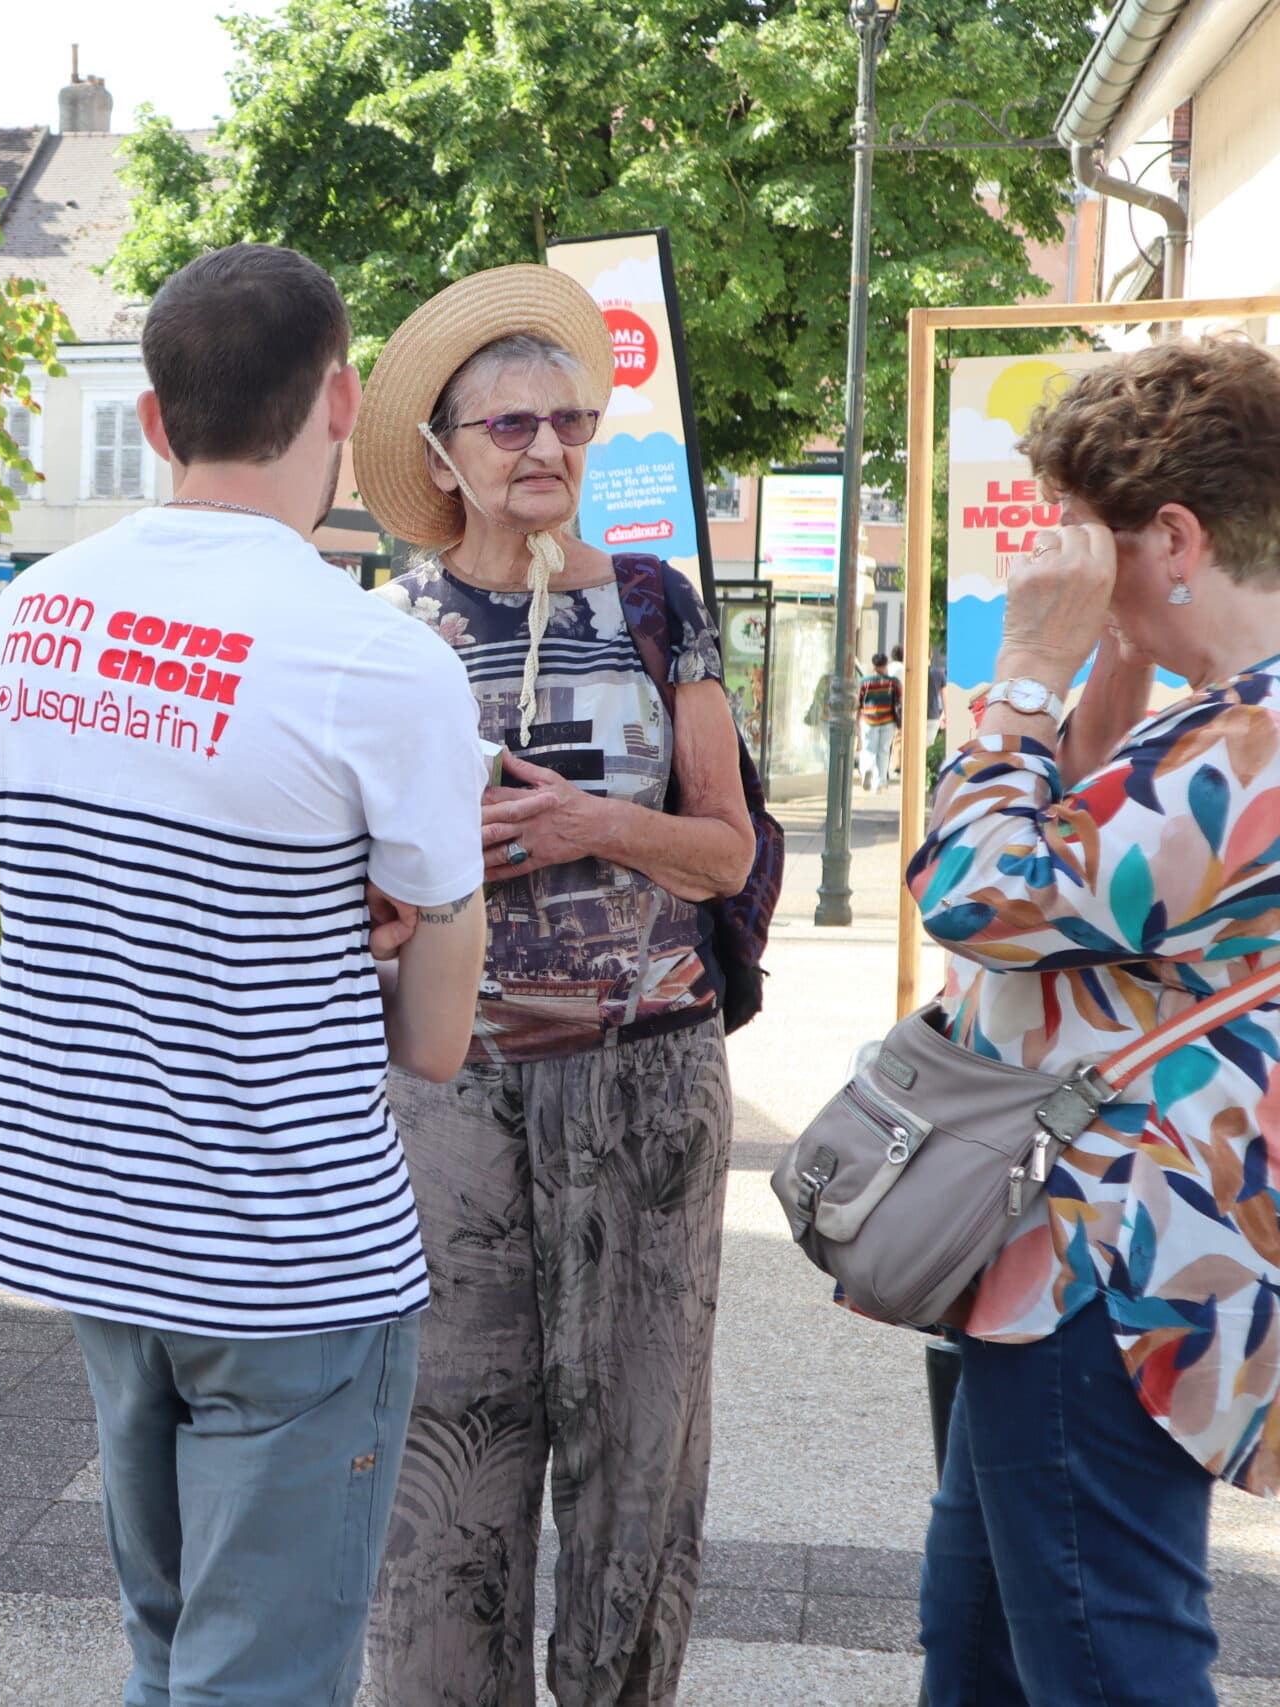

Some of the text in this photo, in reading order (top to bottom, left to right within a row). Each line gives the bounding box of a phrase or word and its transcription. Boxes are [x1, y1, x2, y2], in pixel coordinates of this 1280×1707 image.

[610, 328, 646, 345] MD
[653, 463, 675, 472] tout
[624, 484, 677, 497] directives
[987, 480, 1037, 502] LE
[963, 505, 1062, 528] MOU
[12, 593, 254, 663] mon corps
[1, 631, 242, 706] mon choix
[419, 913, 454, 924] MORI
